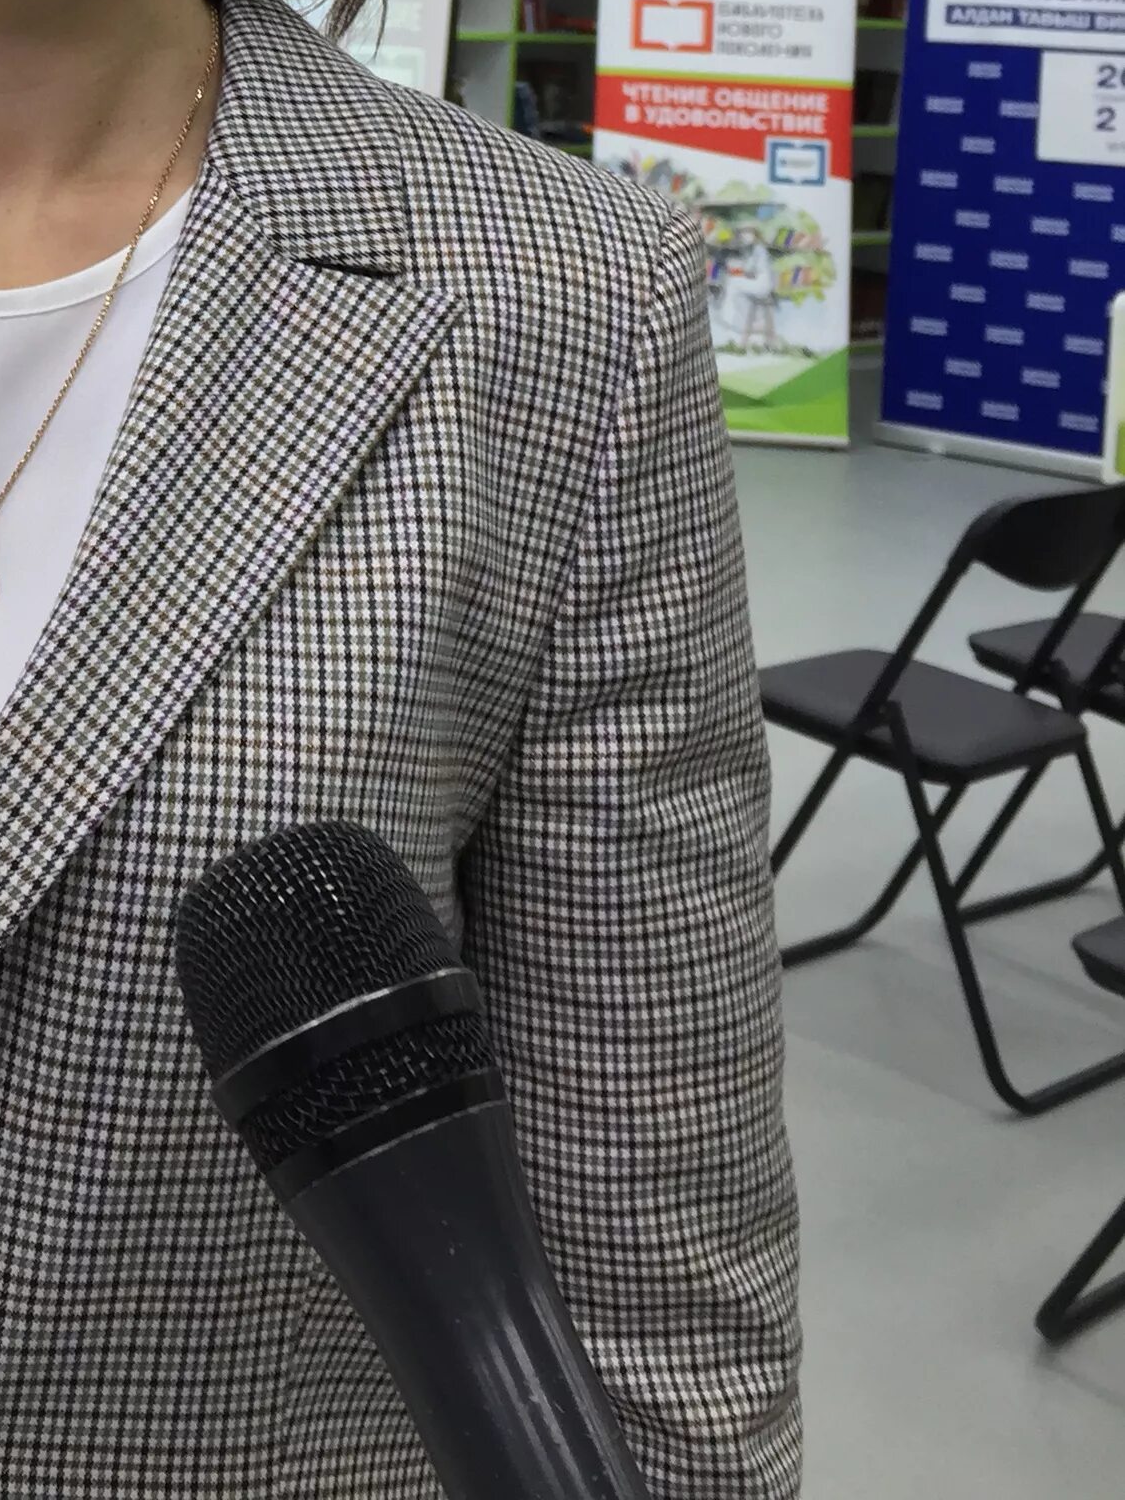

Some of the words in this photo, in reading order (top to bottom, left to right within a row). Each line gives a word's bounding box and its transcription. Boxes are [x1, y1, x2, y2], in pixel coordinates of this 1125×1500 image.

[1097, 63, 1125, 89] 2
[622, 83, 708, 106] ЧТЕНИЕ
[714, 89, 829, 113] ОБЩЕНИЕ
[624, 105, 640, 123] В
[645, 106, 826, 134] УДОВОЛЬСТВИЕ
